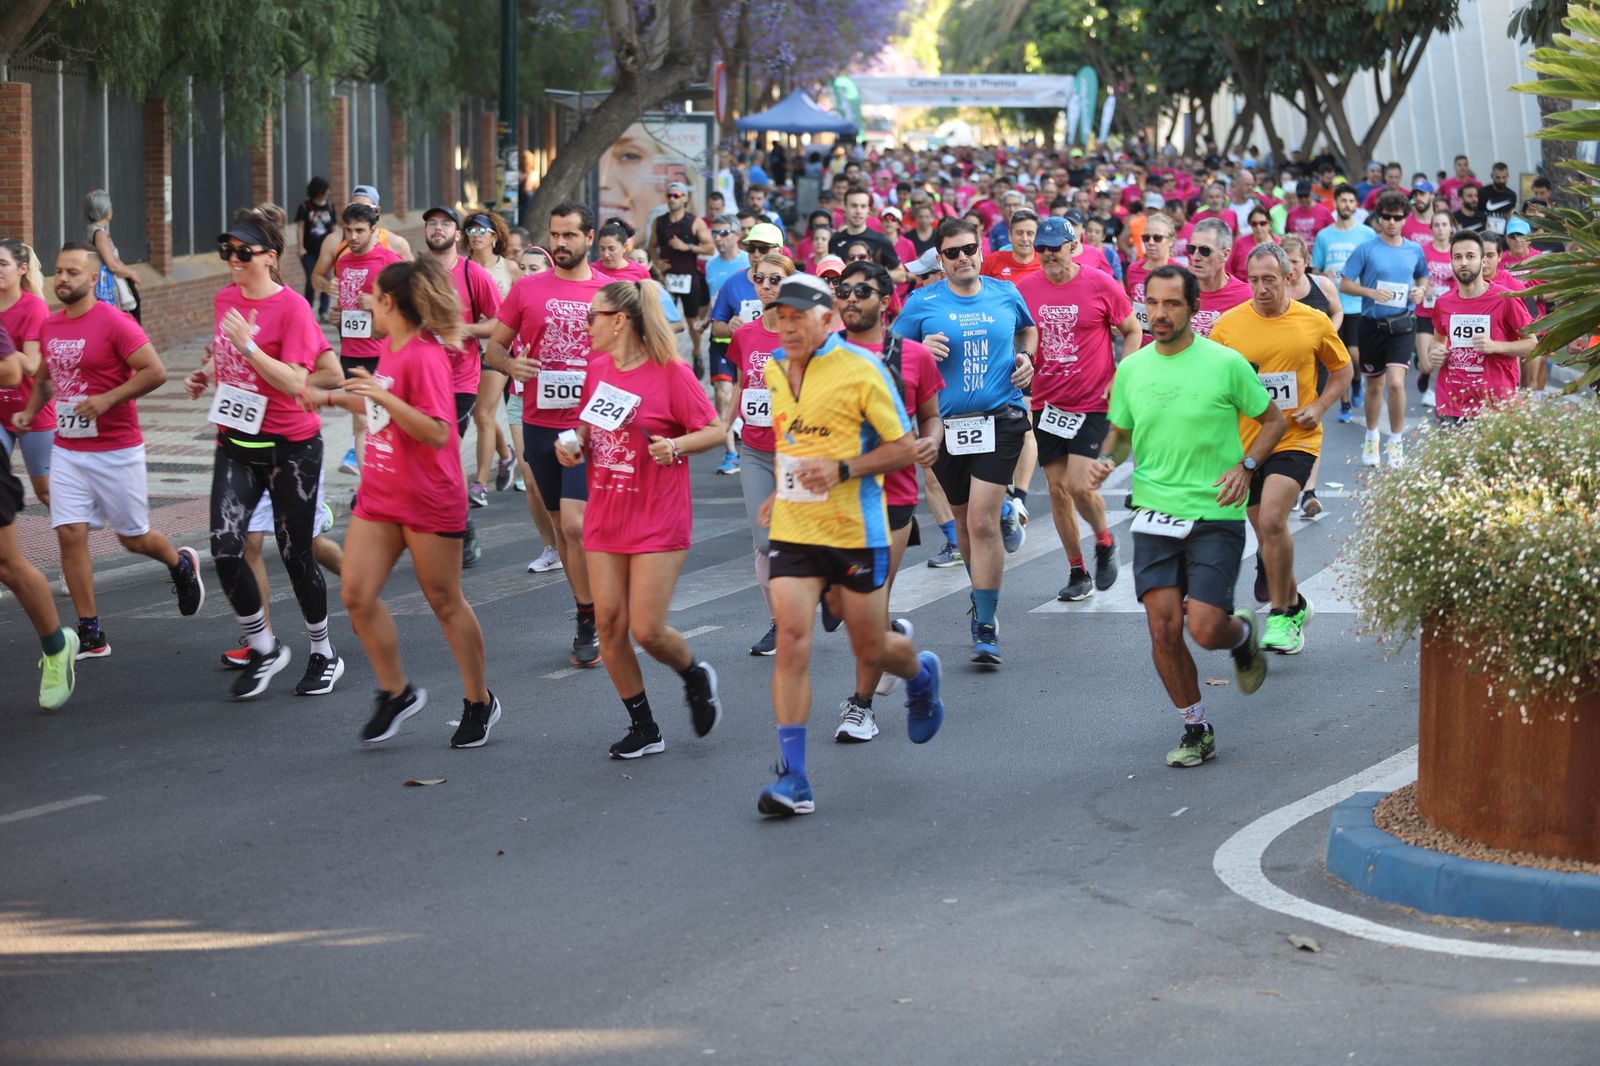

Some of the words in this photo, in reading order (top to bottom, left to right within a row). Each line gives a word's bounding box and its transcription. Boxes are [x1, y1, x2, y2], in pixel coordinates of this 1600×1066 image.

[344, 320, 367, 331] 497
[218, 399, 257, 422] 296
[590, 398, 625, 421] 224
[1045, 411, 1078, 430] 562
[957, 429, 983, 445] 52
